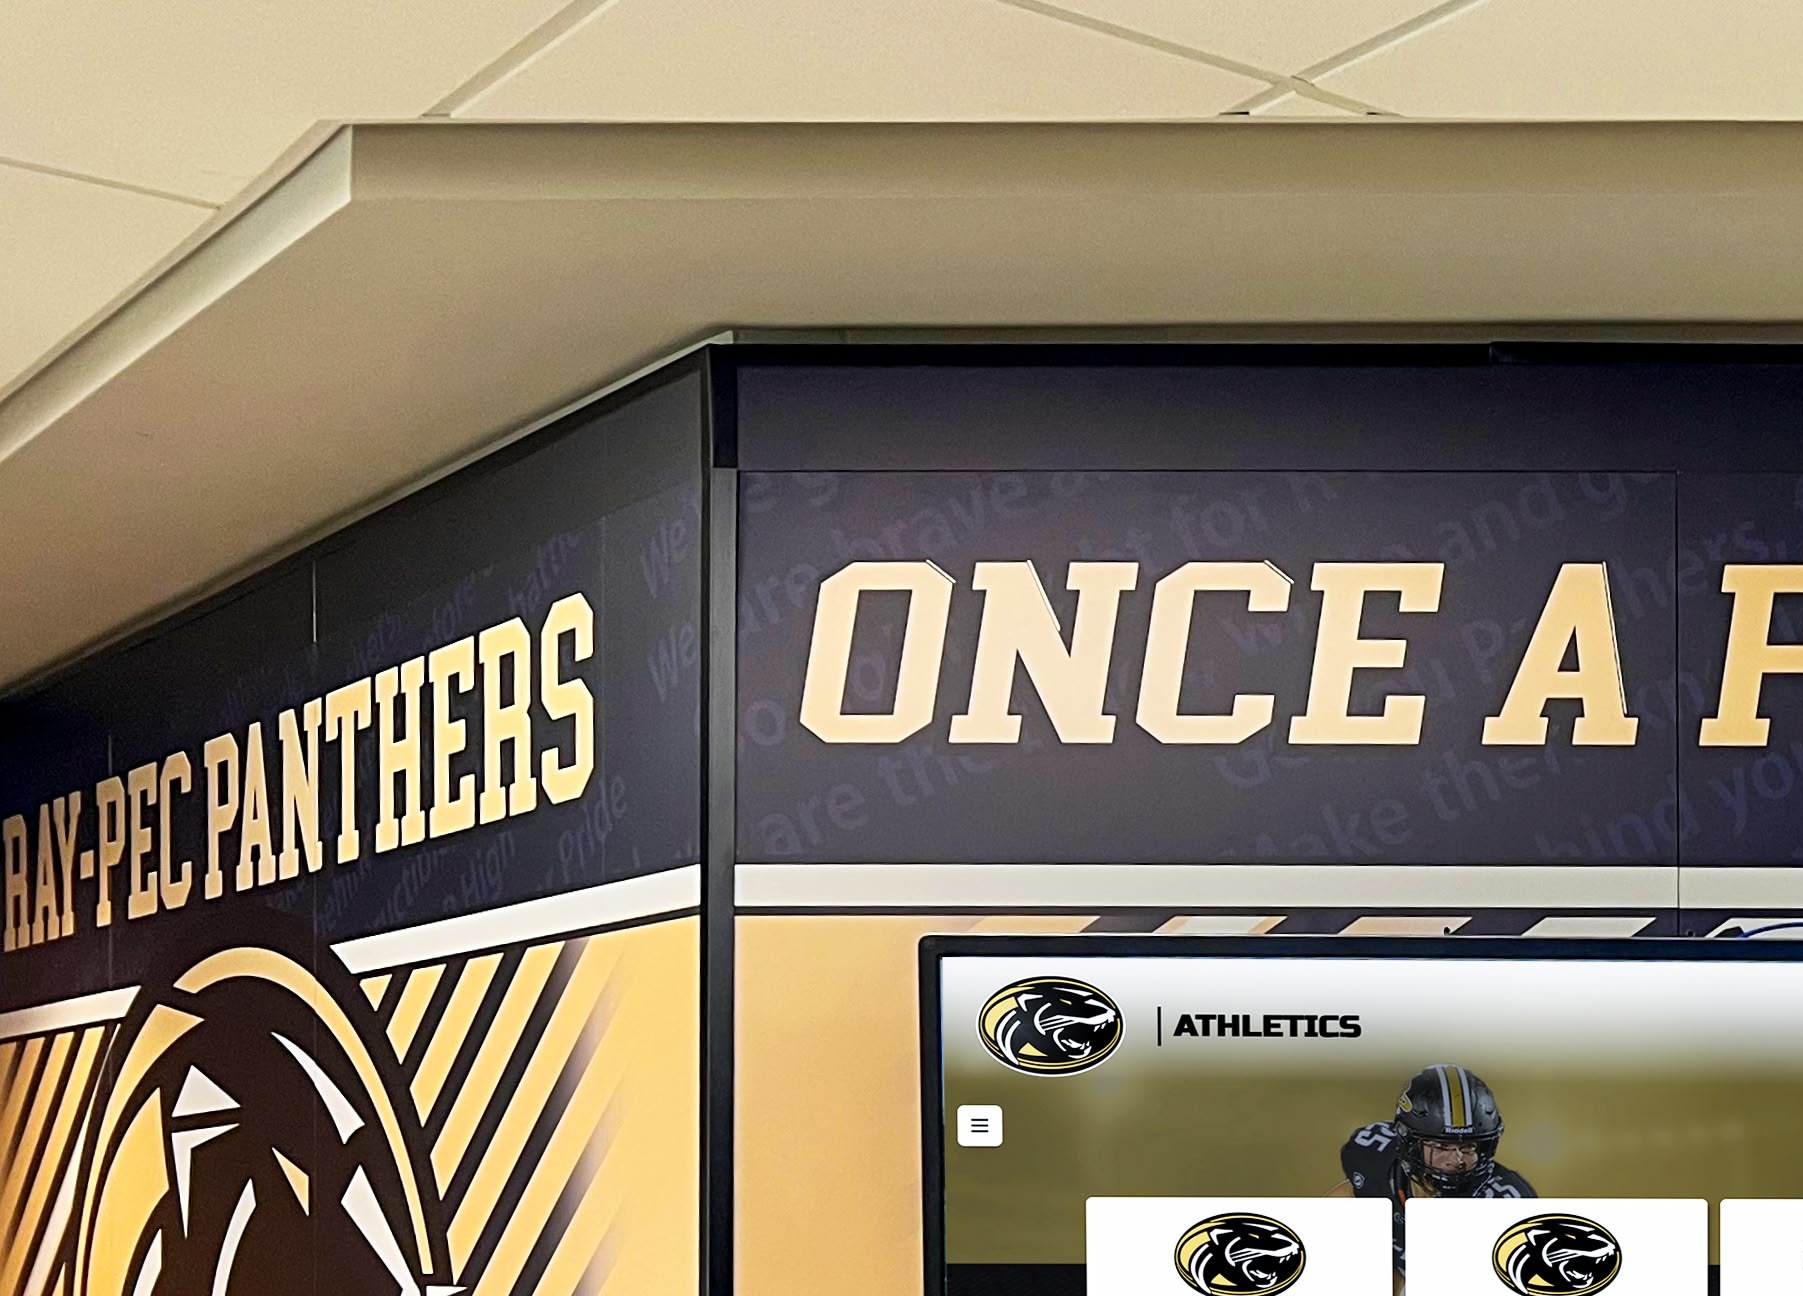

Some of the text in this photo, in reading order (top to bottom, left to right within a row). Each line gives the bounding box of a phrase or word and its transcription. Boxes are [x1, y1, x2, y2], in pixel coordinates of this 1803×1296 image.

[803, 562, 1445, 745] ONCE
[1483, 563, 1639, 746] A
[3, 594, 595, 952] RAY-PEC PANTHERS
[1172, 1013, 1363, 1038] ATHLETICS
